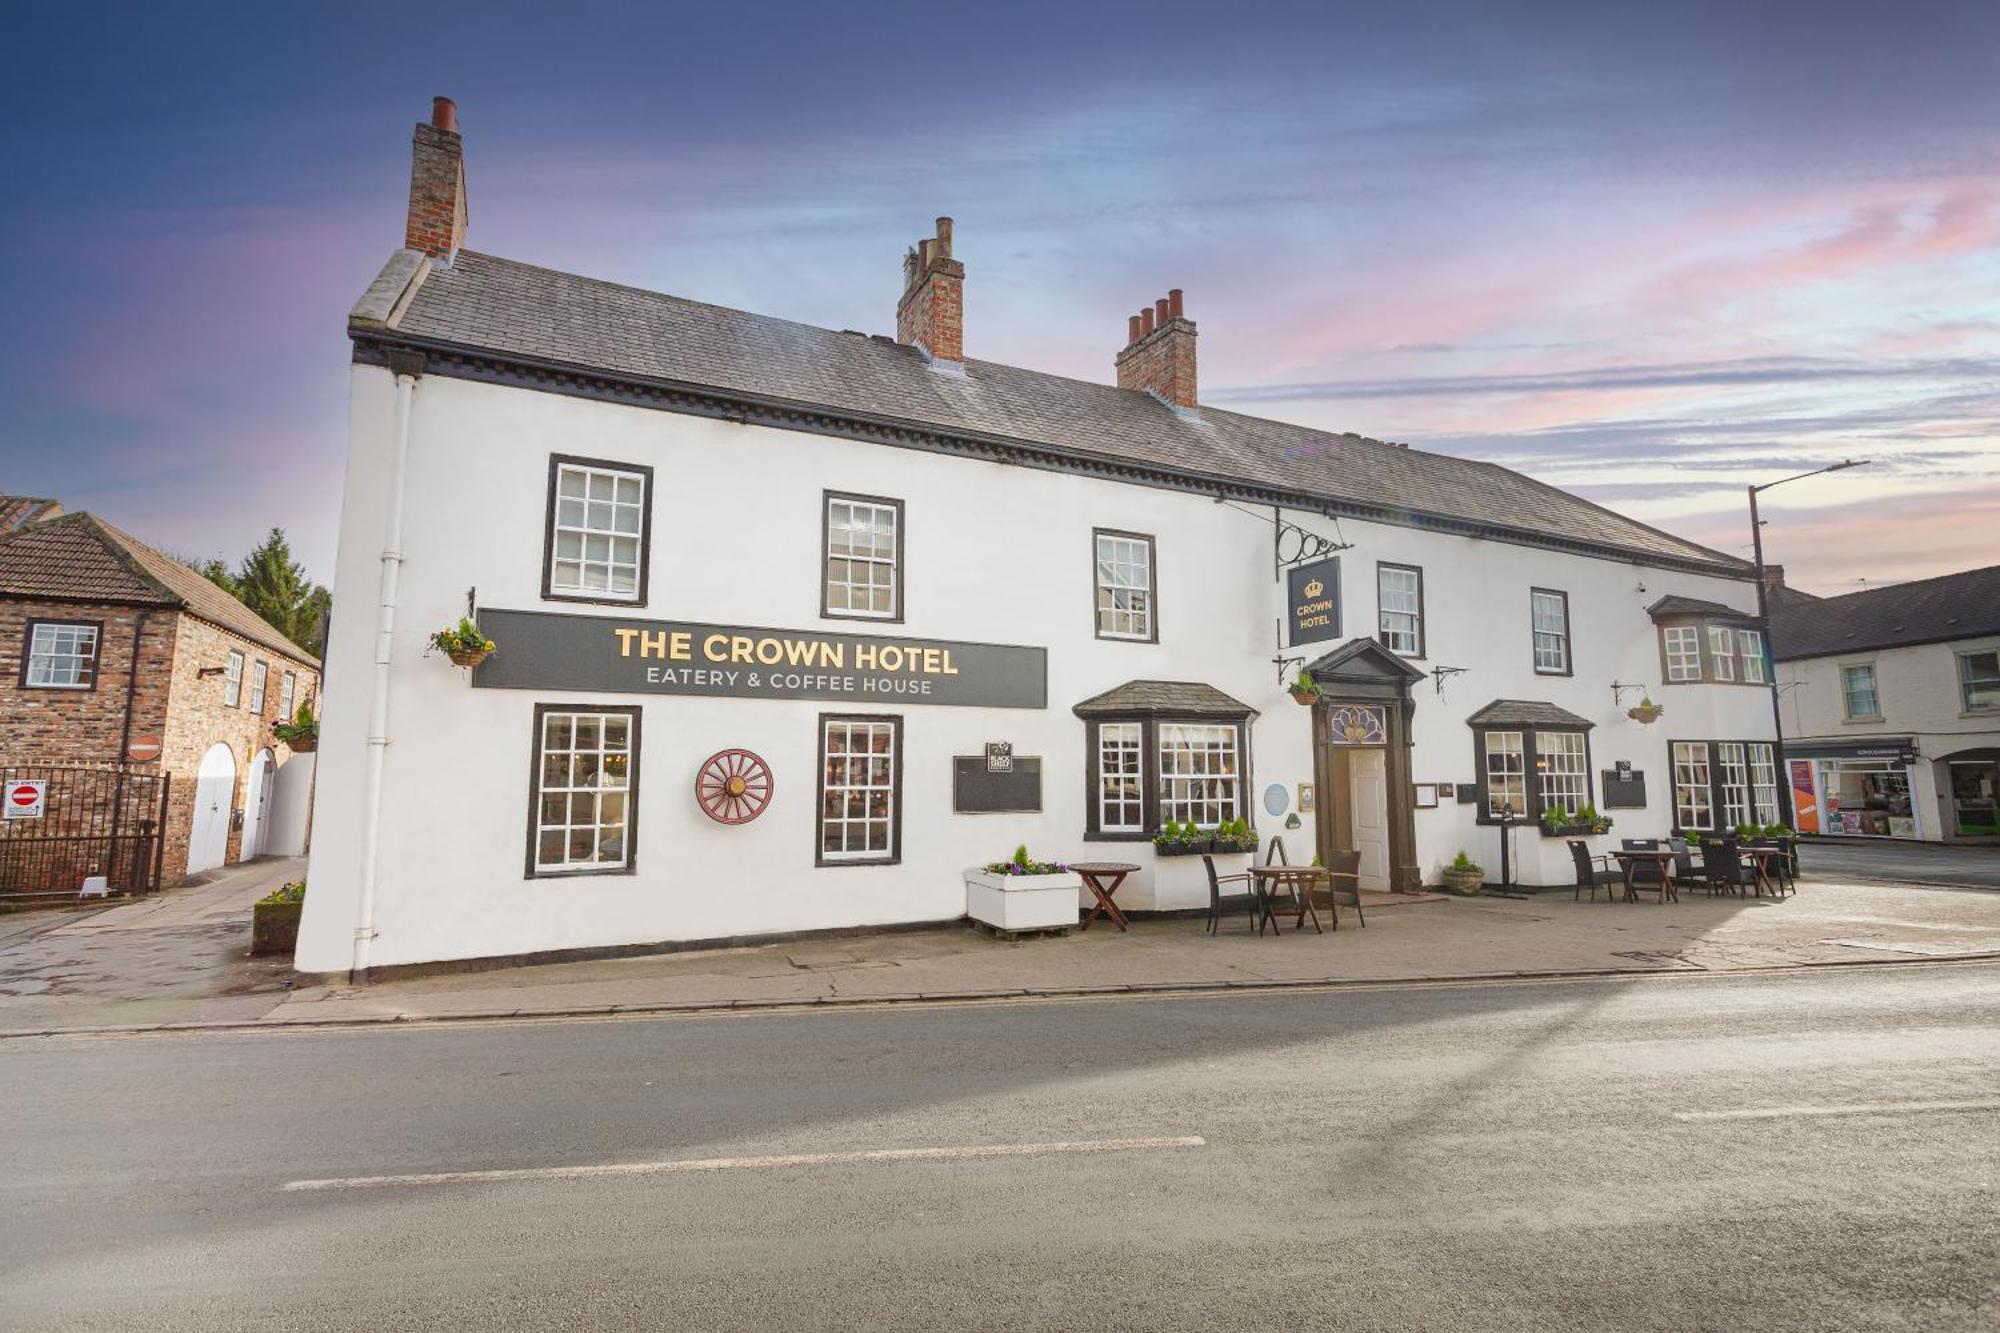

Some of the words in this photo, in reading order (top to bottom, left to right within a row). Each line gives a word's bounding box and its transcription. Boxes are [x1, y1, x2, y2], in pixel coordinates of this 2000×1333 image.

[1297, 600, 1333, 616] CROWN
[1301, 615, 1330, 629] HOTEL
[614, 628, 692, 660] THE
[703, 634, 843, 669] CROWN
[855, 644, 959, 675] HOTEL
[647, 667, 740, 686] EATERY
[747, 673, 761, 687] &
[770, 674, 854, 692] COFFEE
[863, 677, 932, 694] HOUSE
